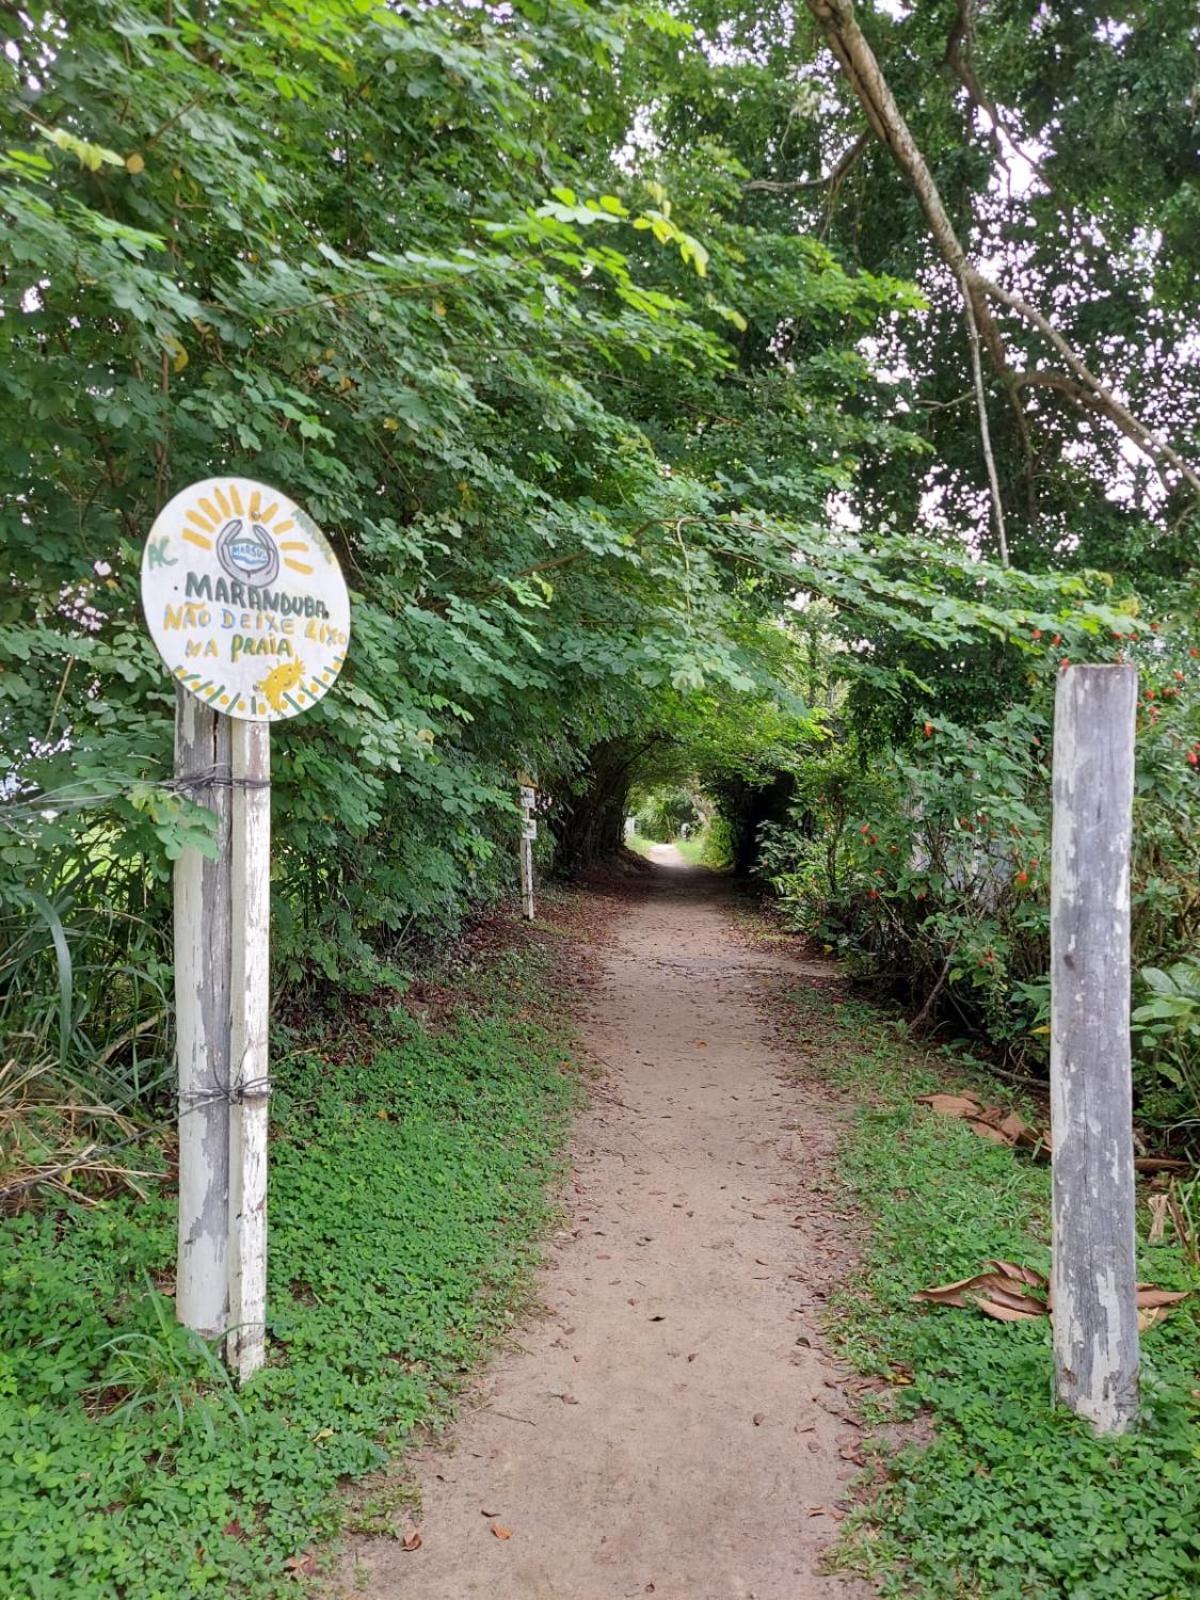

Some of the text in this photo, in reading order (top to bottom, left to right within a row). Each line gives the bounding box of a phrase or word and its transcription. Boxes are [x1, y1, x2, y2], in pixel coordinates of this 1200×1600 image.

[163, 601, 347, 648] NÃO DEIXE LIXO
[185, 637, 219, 658] NA
